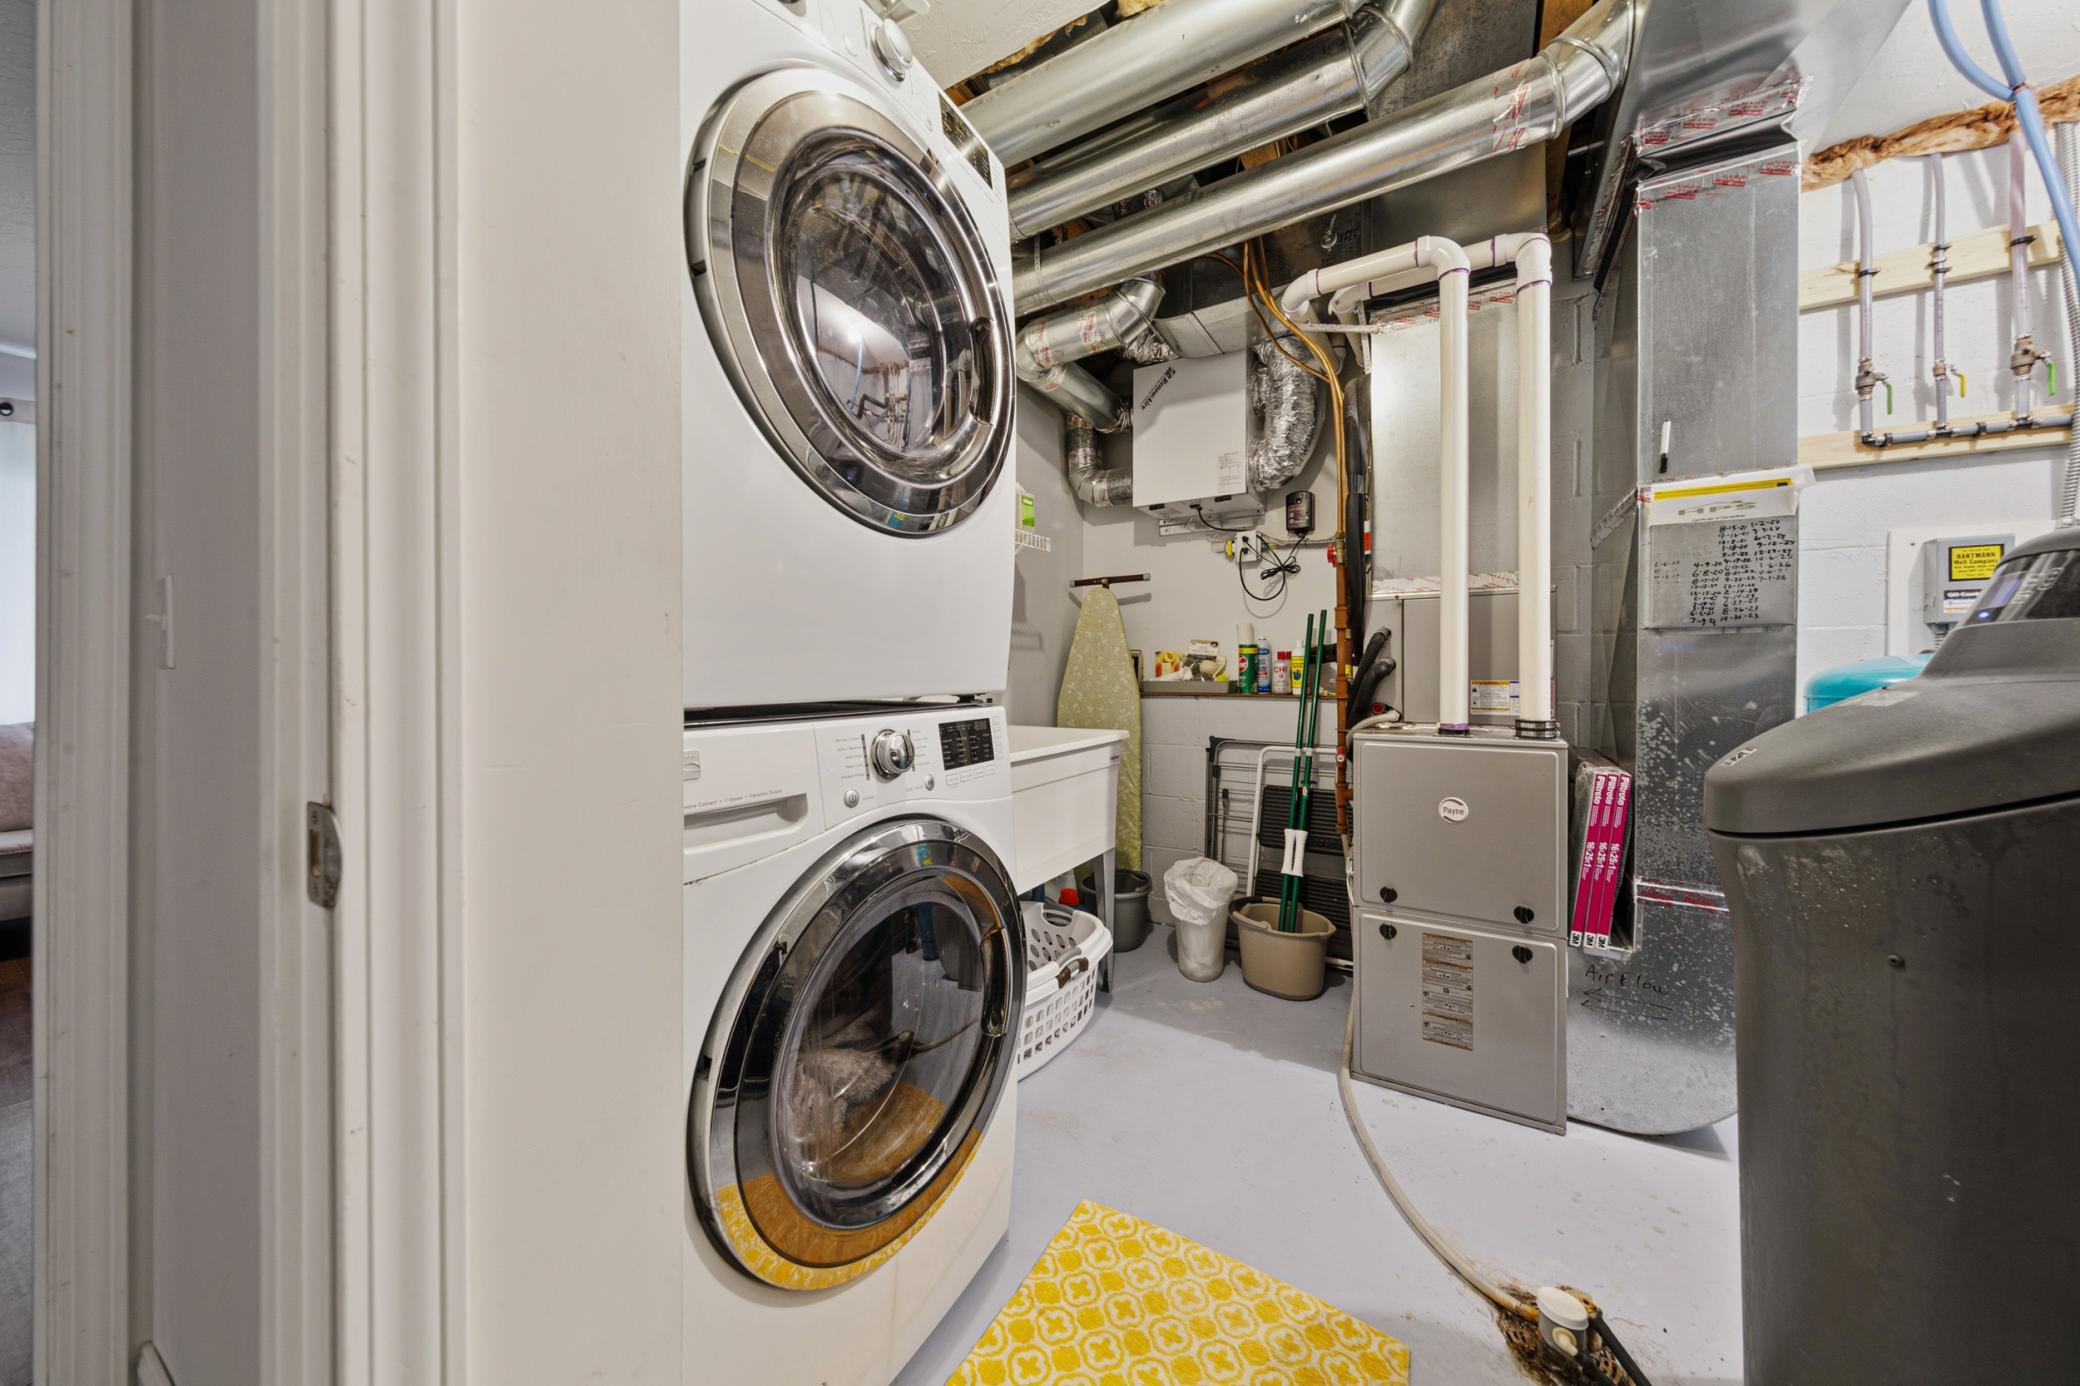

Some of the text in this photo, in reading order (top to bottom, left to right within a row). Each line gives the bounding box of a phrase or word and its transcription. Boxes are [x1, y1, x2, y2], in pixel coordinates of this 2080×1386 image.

[1442, 806, 1465, 816] Payne
[1571, 932, 1581, 945] 3M
[1585, 934, 1594, 948] 3M
[1597, 936, 1607, 949] 3M
[1585, 964, 1670, 996] Air Flow
